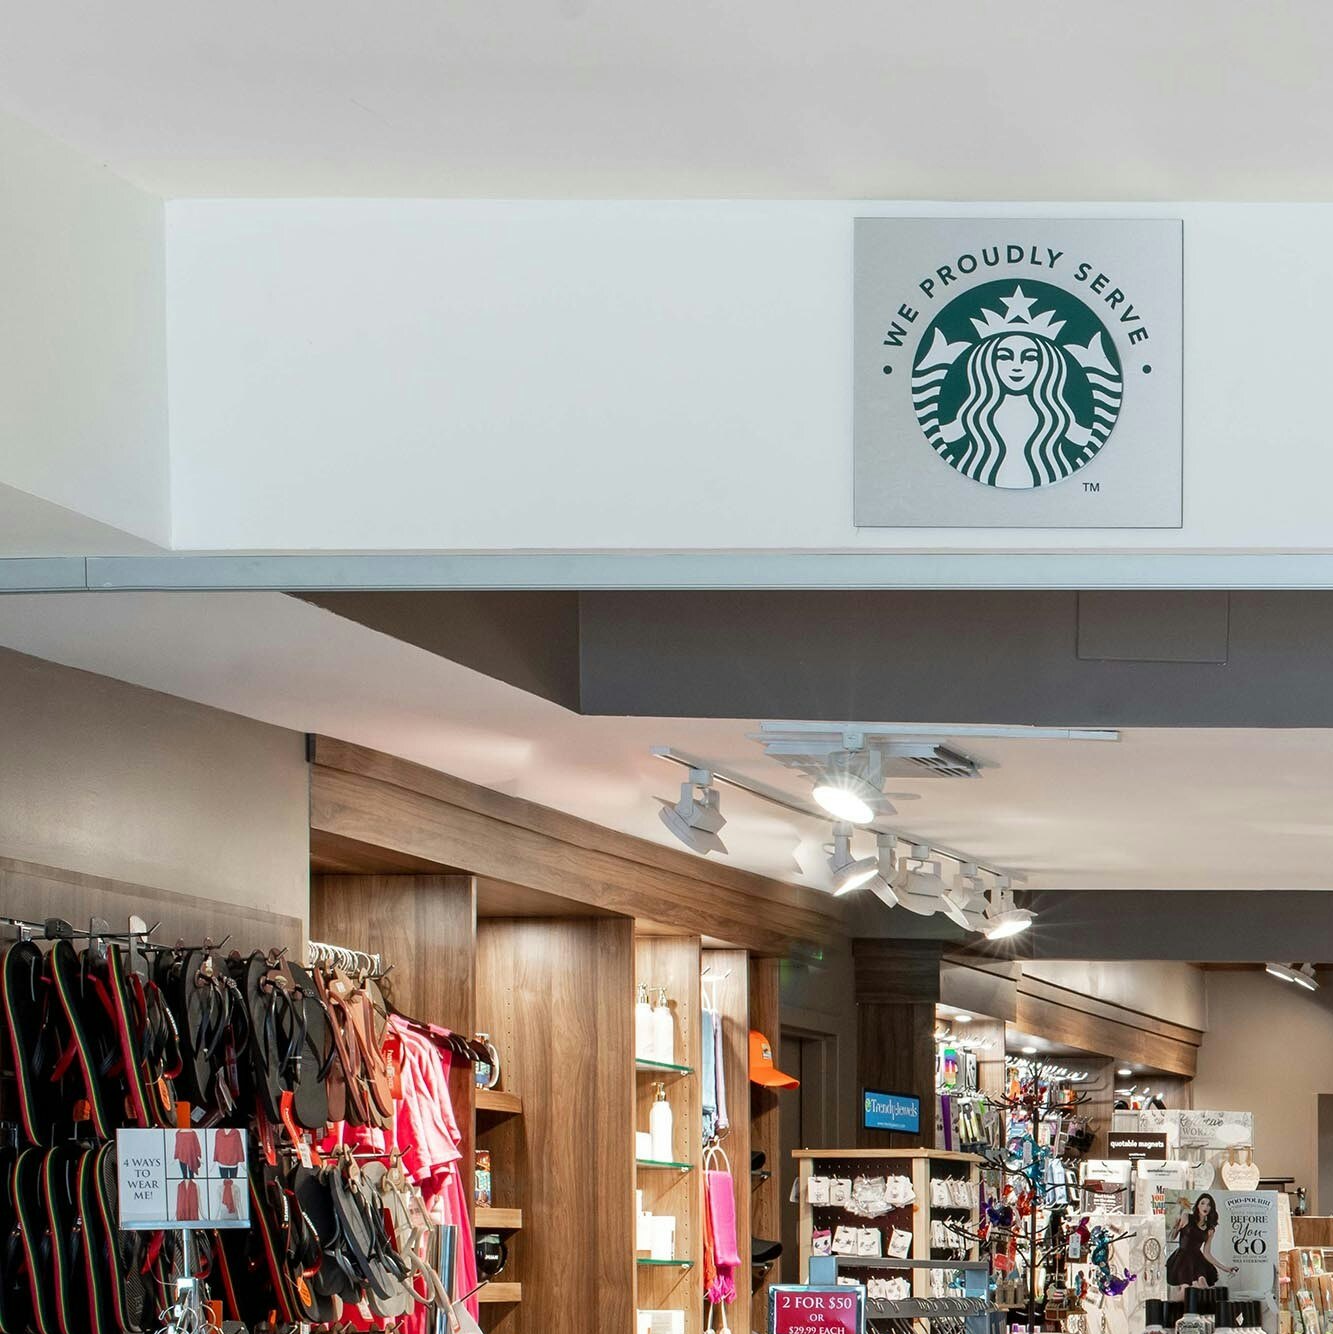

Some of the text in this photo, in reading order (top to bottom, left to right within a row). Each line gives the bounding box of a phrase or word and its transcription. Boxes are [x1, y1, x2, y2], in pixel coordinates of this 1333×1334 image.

[883, 244, 1150, 347] WE PROUDLY SERVE
[1083, 483, 1100, 492] TM
[1110, 1140, 1164, 1150] quotable magnets
[132, 1158, 161, 1167] WAYS
[134, 1169, 151, 1178] TO
[127, 1180, 159, 1189] WEAR
[134, 1190, 153, 1200] ME!
[1230, 1216, 1268, 1224] BEFORE
[1232, 1222, 1263, 1244] You
[1234, 1239, 1266, 1255] GO
[782, 1296, 852, 1309] 2 FOR $50
[809, 1313, 825, 1322] OR
[789, 1326, 845, 1334] $29.99 EACH
